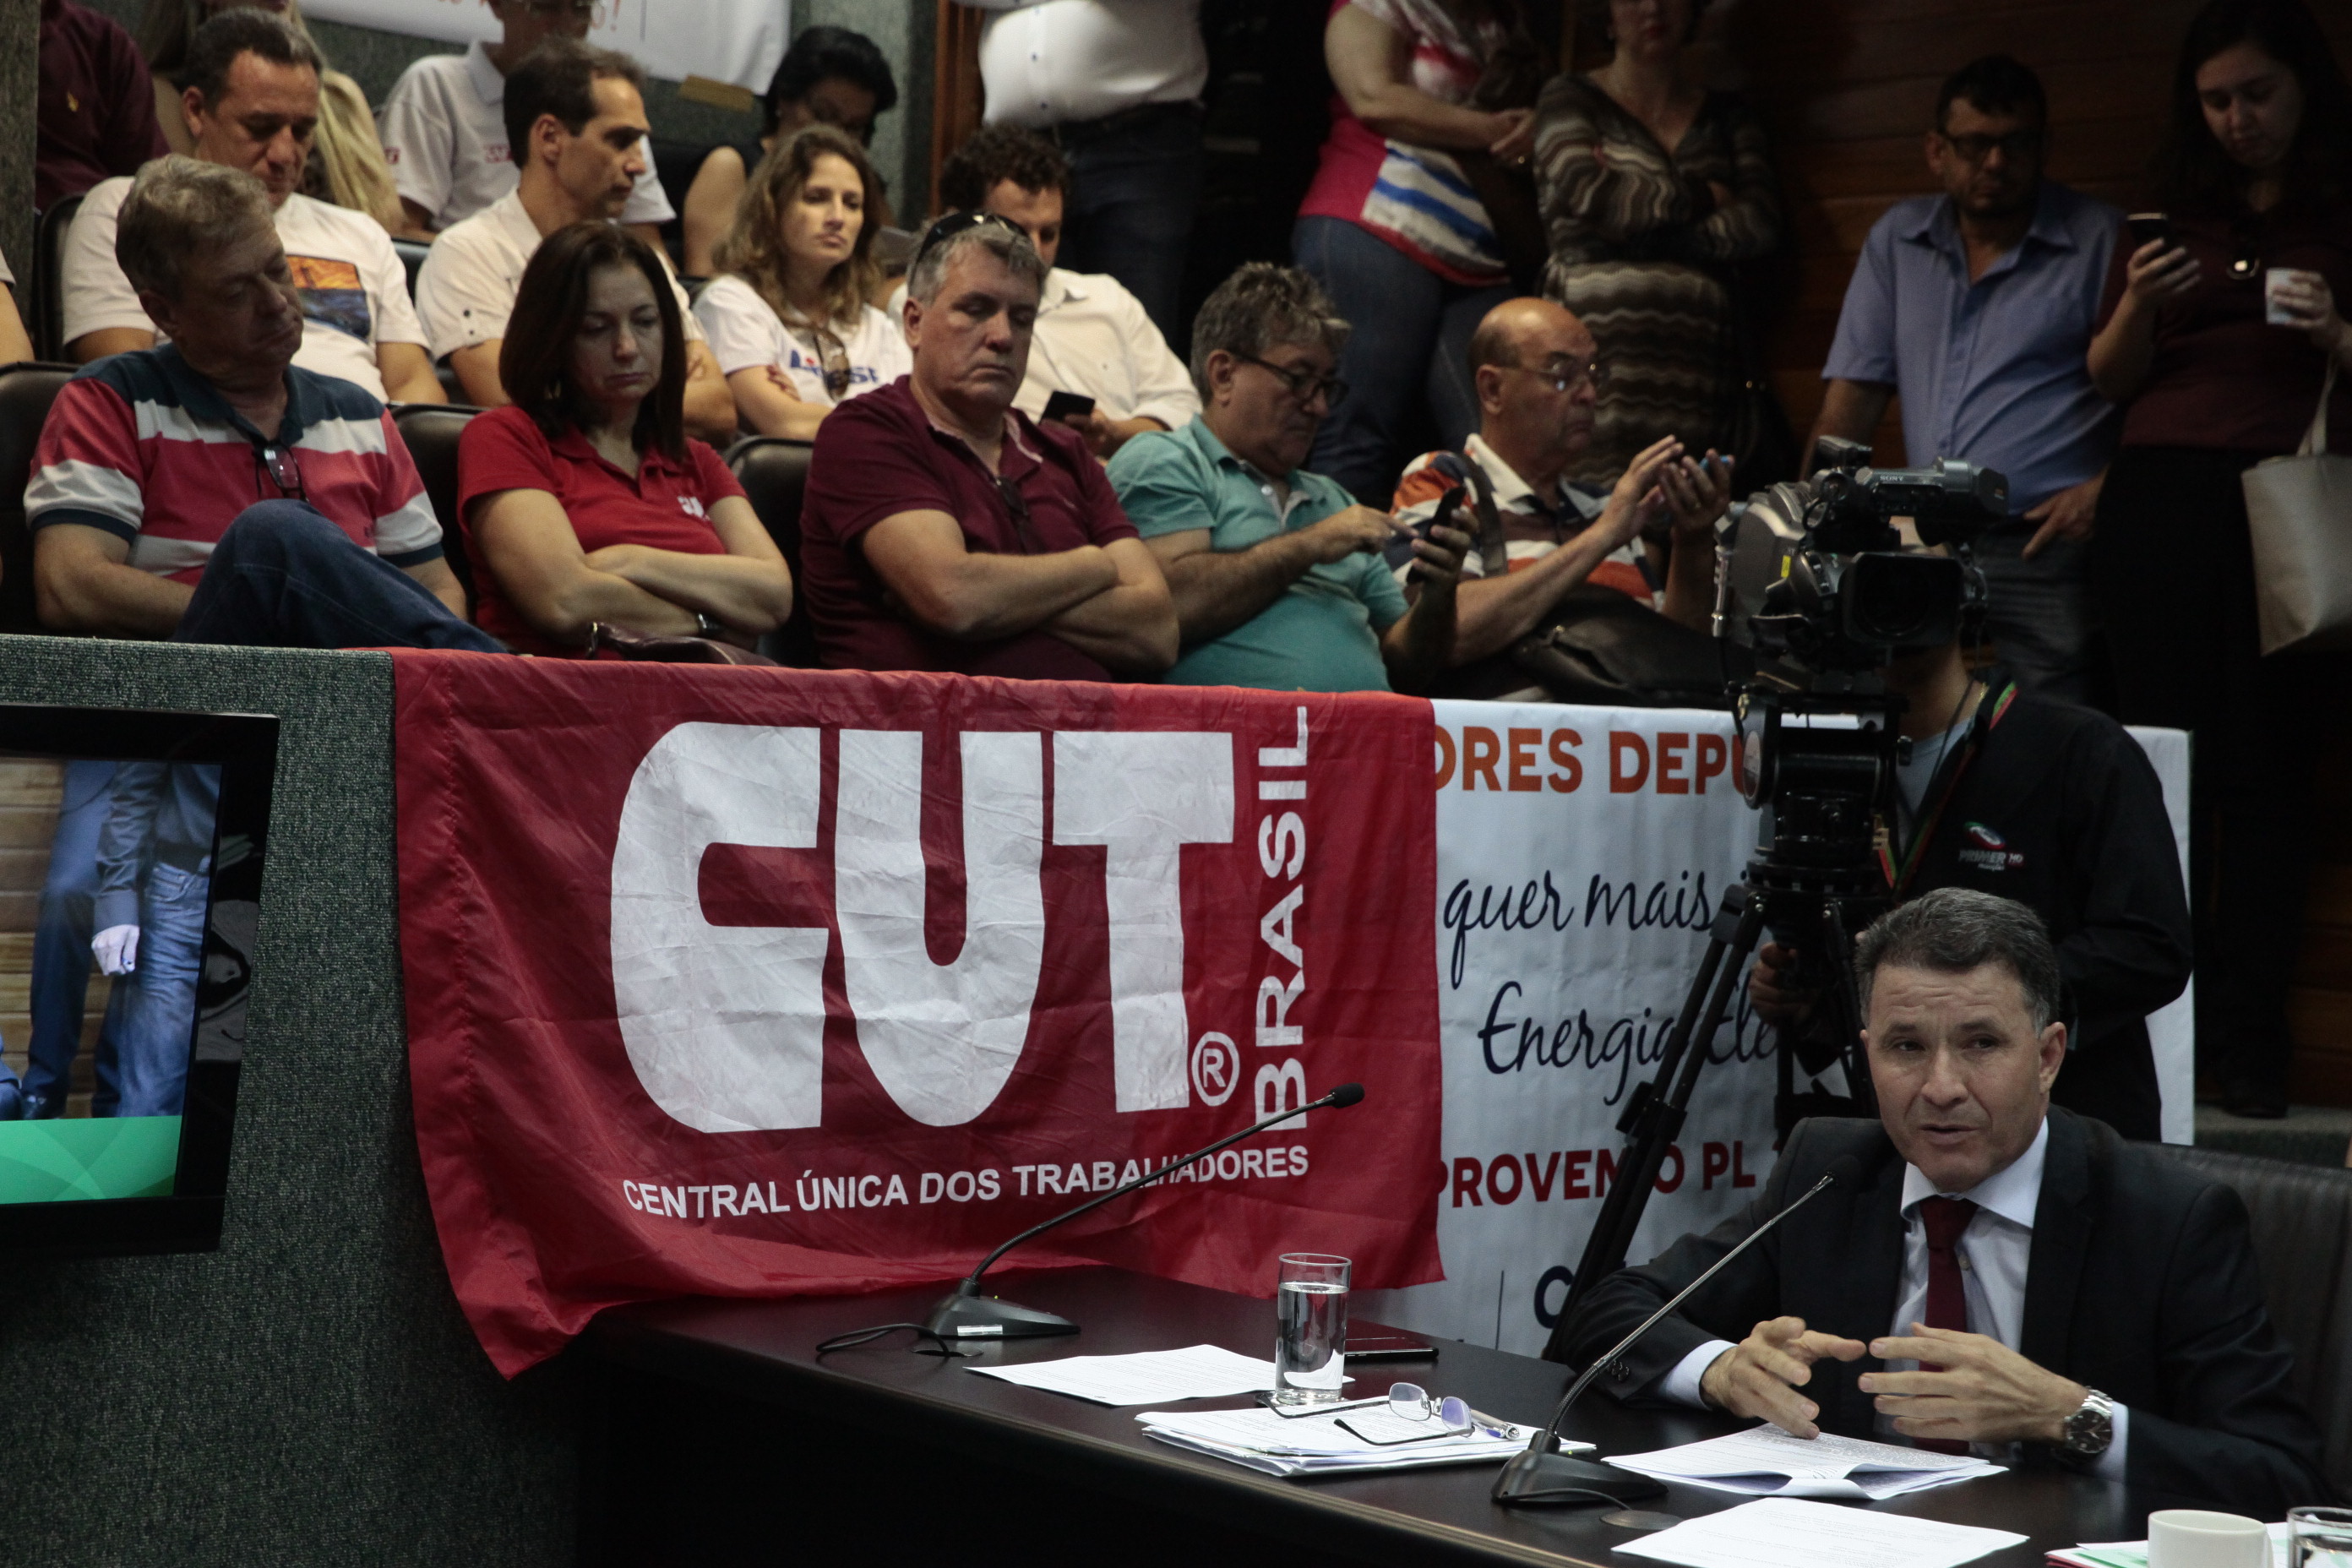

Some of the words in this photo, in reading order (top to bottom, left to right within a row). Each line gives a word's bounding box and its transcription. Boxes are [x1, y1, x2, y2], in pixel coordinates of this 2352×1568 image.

[610, 721, 1235, 1134] CUT
[1254, 705, 1309, 1131] BRASIL
[1444, 870, 1575, 990] quer
[1584, 870, 1715, 931] mais
[623, 1179, 791, 1219] CENTRAL
[796, 1169, 909, 1211] ÚNICA
[919, 1168, 1001, 1204] DOS
[1012, 1145, 1309, 1196] TRABALHADORES
[1702, 1141, 1756, 1190] PL
